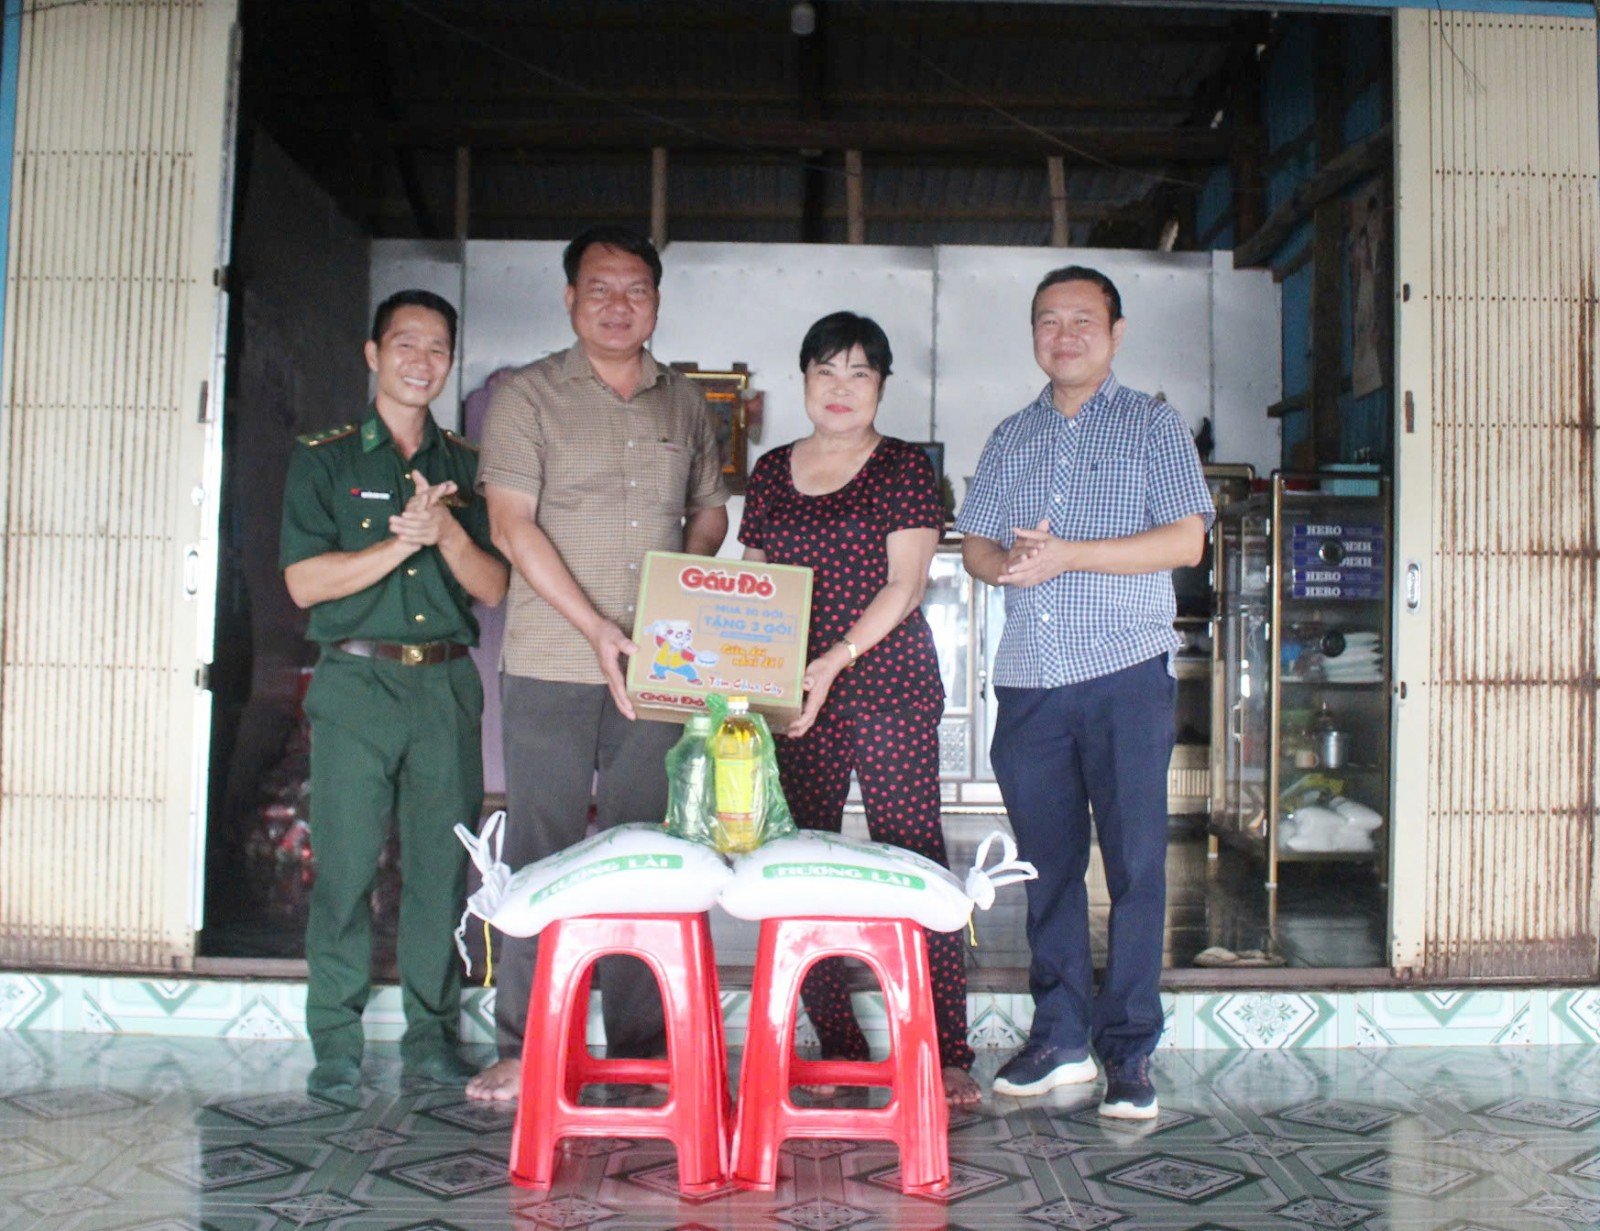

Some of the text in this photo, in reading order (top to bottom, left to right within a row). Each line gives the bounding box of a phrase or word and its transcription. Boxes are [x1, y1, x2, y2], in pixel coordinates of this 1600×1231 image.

[1306, 525, 1342, 536] HERO
[681, 567, 774, 597] Gấu Đỏ
[1305, 571, 1342, 582] HERO
[1305, 586, 1342, 597] HERO
